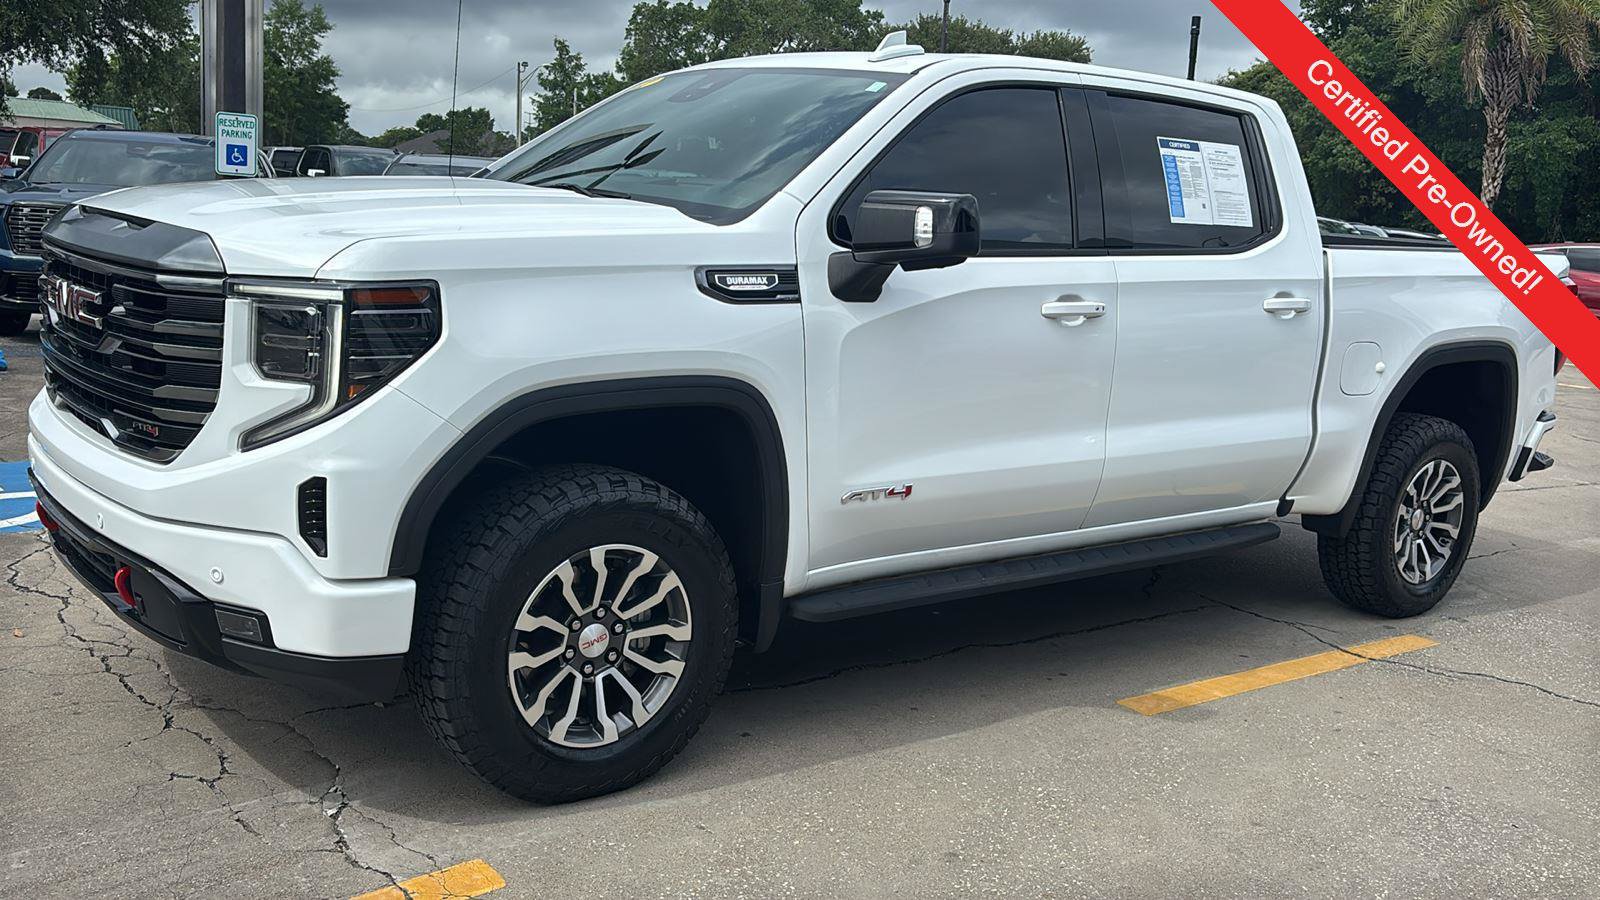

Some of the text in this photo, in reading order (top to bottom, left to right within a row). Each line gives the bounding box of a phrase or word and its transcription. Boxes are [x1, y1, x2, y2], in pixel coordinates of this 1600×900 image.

[218, 118, 255, 129] RESERVED
[221, 129, 253, 139] PARKING
[726, 276, 768, 285] DURAMAX
[38, 274, 102, 330] GMC
[841, 483, 913, 504] AT4
[581, 633, 607, 650] GMC
